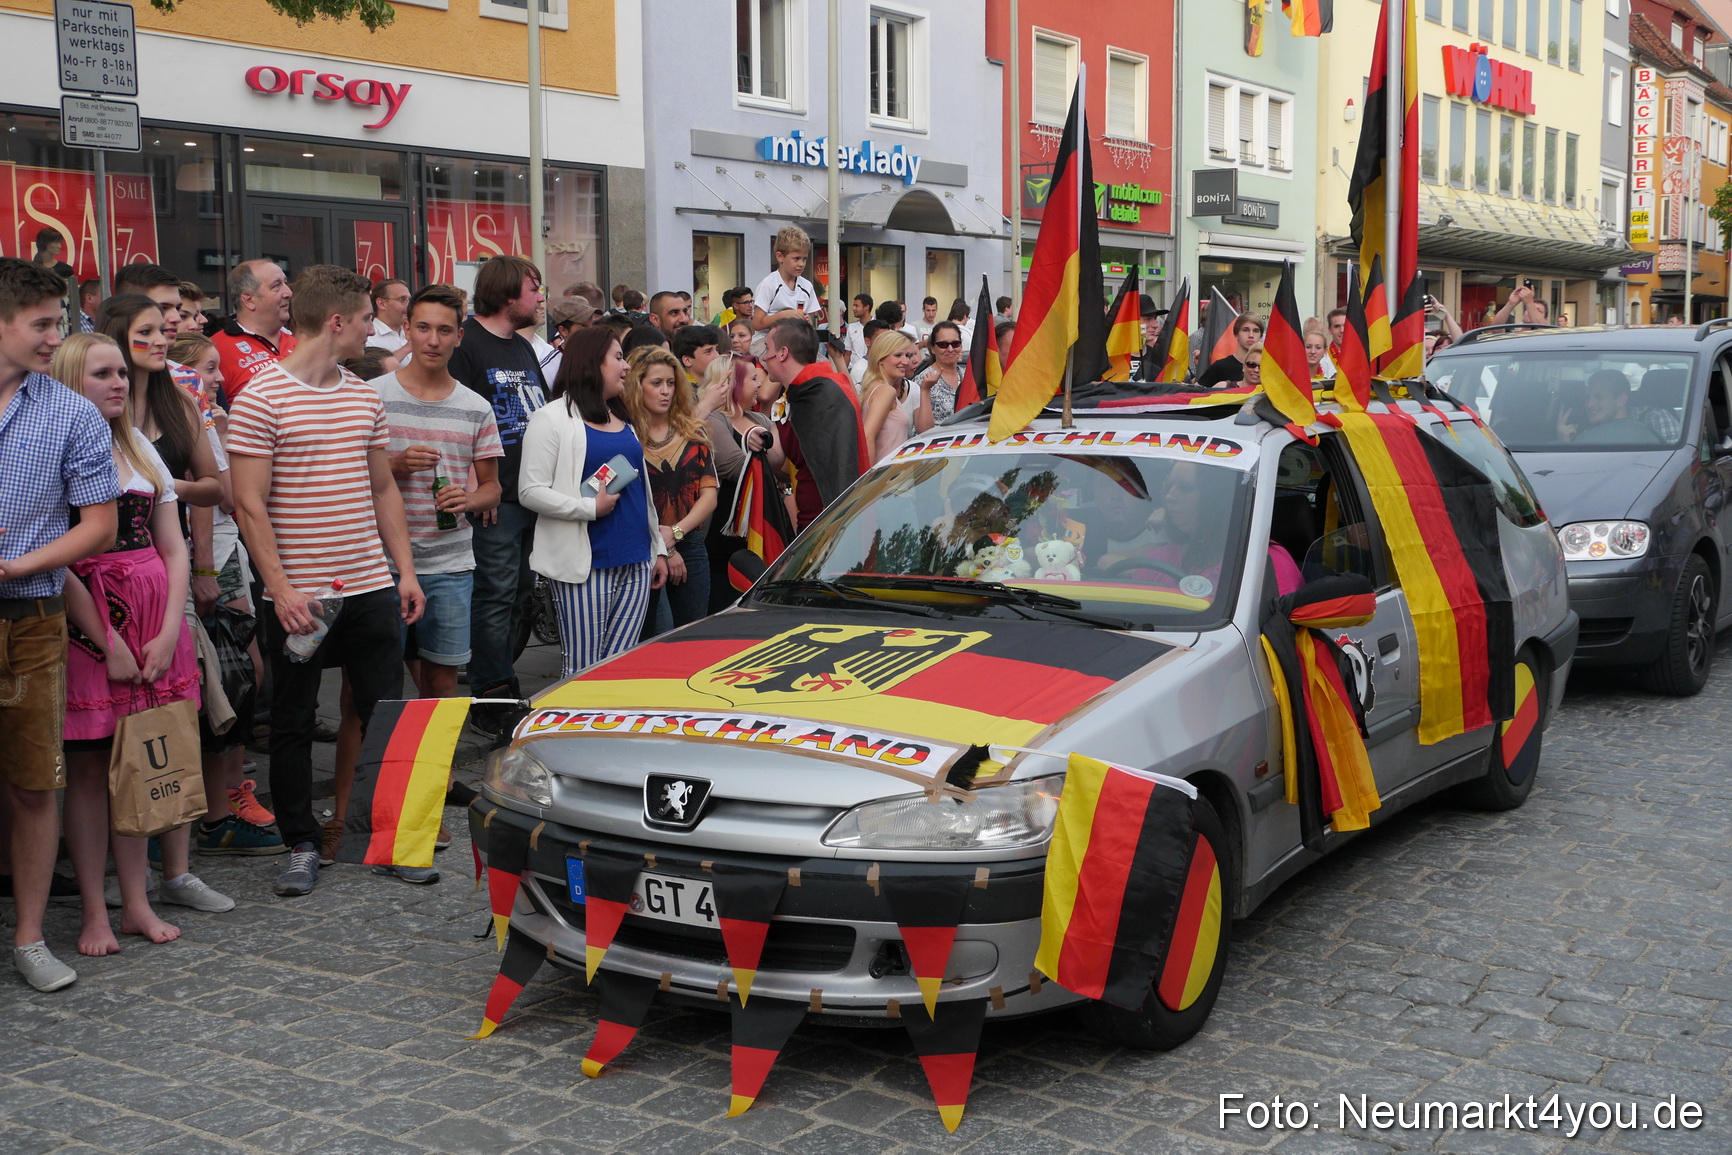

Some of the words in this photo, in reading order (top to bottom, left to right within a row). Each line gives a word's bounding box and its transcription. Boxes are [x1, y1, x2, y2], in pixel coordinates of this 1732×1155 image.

[72, 7, 93, 19] nur
[99, 9, 118, 22] mit
[62, 18, 129, 38] Parkschein
[69, 37, 125, 55] werktags
[64, 70, 78, 82] Sa
[244, 65, 413, 129] orsay
[99, 104, 127, 113] Parkschein
[67, 115, 84, 123] Anruf
[81, 130, 95, 138] SMS
[1635, 70, 1652, 207] BÄCKEREI
[862, 140, 922, 185] lady
[115, 180, 147, 200] SALE
[1110, 182, 1162, 205] mobilcom
[1109, 203, 1141, 224] debitel
[1631, 212, 1649, 223] café
[527, 710, 931, 766] DEUTSCHLAND
[142, 734, 169, 770] U
[150, 779, 182, 801] eins
[574, 884, 582, 896] D
[645, 877, 685, 918] GT
